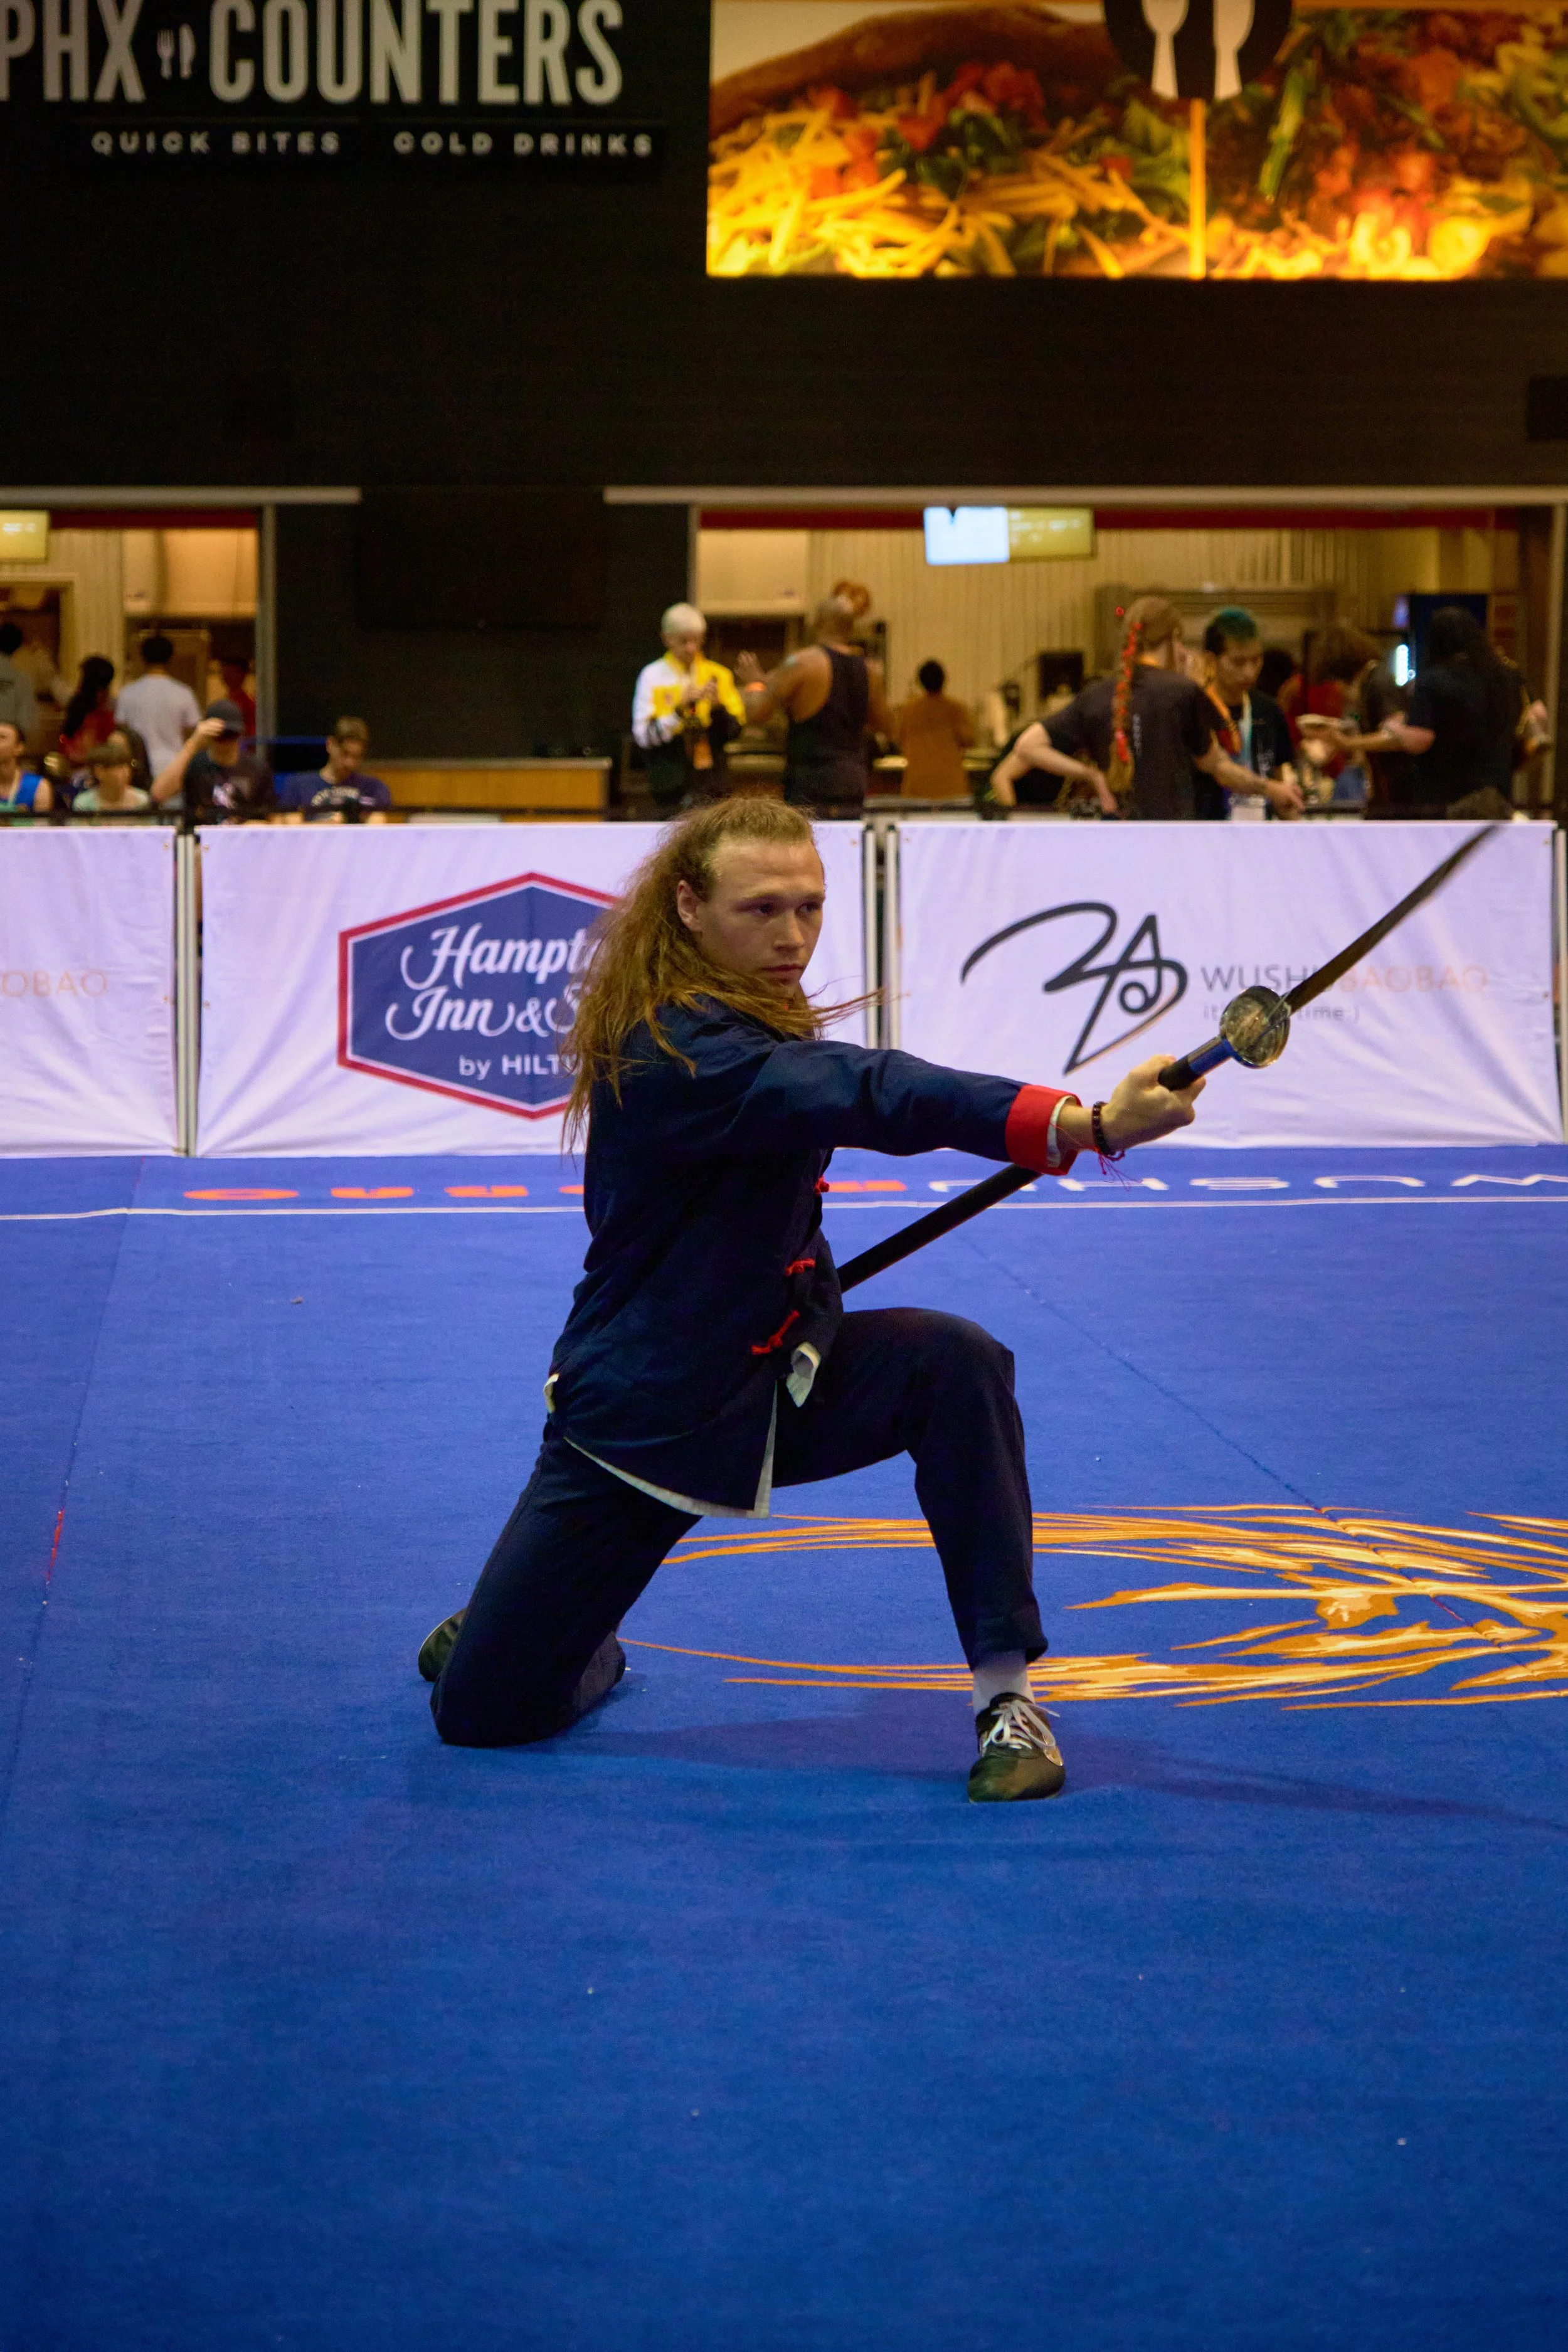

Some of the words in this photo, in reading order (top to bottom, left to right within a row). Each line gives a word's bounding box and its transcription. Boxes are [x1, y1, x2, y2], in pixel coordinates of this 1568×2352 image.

[0, 0, 146, 102] PHX
[209, 0, 622, 104] COUNTERS
[91, 130, 209, 156] QUICK
[231, 131, 339, 155] BITES
[393, 131, 492, 156] COLD
[514, 132, 652, 157] DRINKS
[401, 922, 602, 990] Hampt
[386, 986, 516, 1040] Inn
[460, 1055, 491, 1080] by
